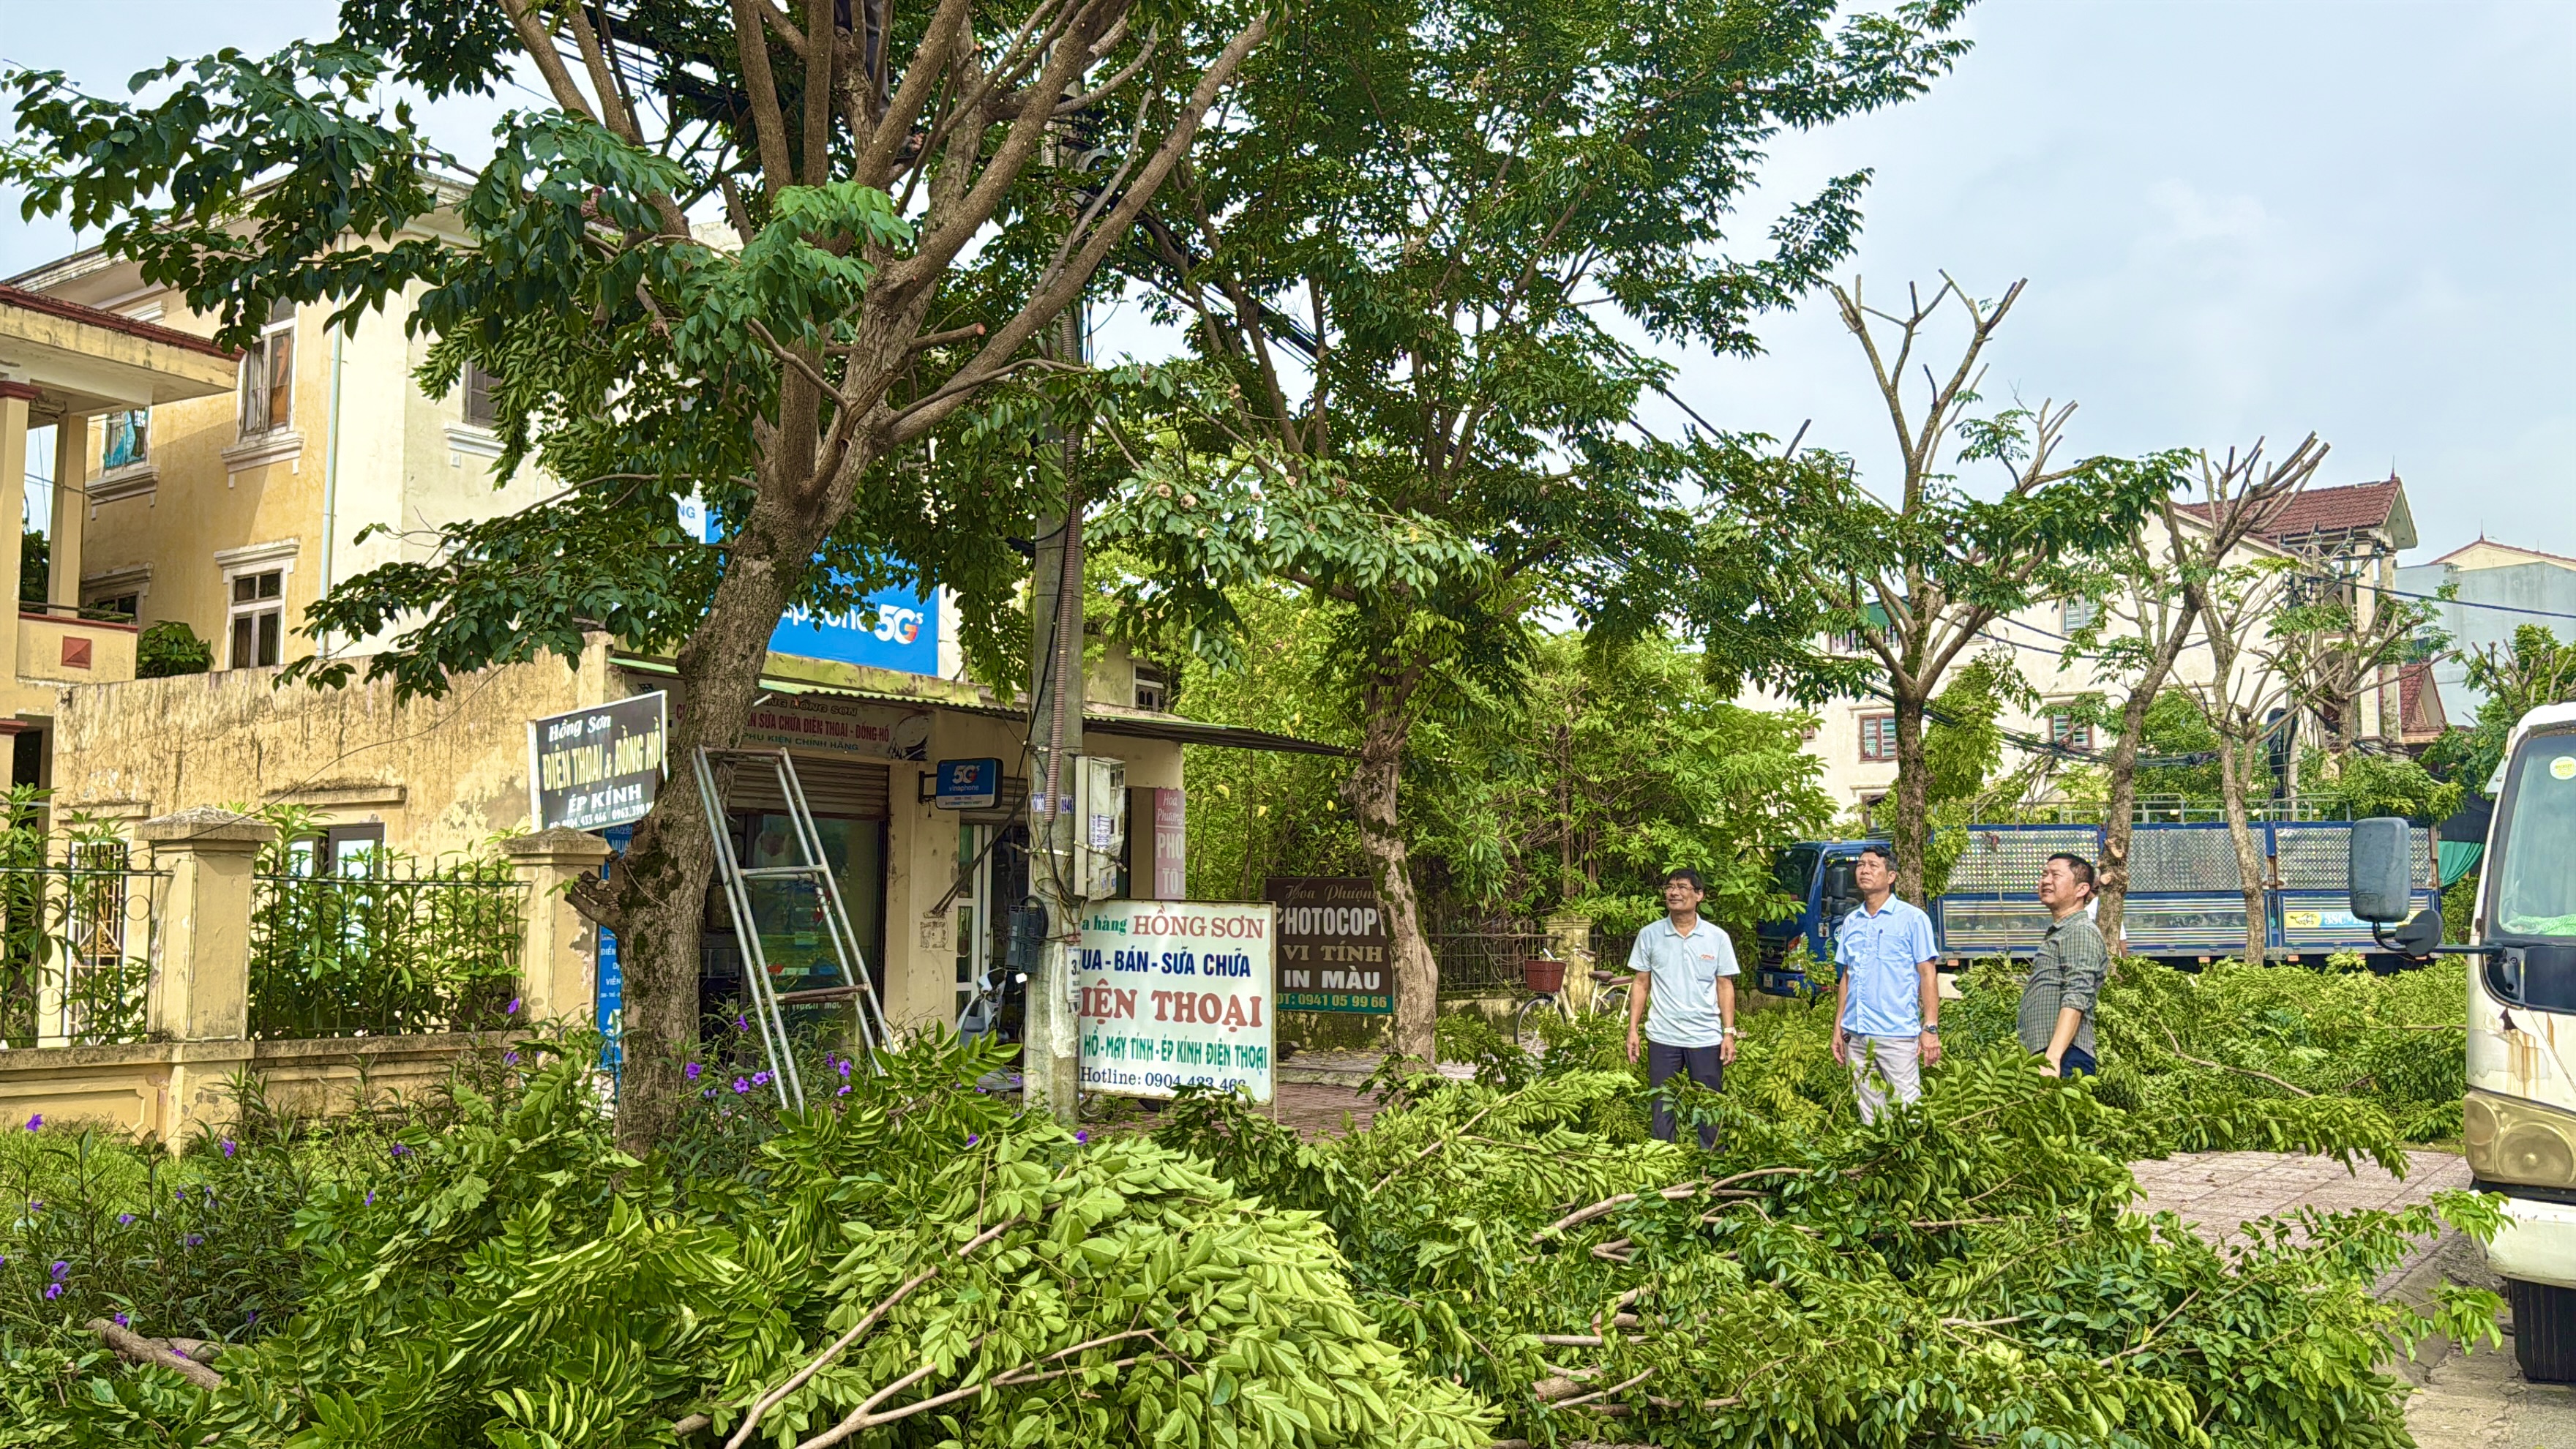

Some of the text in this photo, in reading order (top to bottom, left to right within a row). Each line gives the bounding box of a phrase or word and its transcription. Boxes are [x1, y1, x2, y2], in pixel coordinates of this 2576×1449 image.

[549, 715, 611, 742] Hồng Sơn
[542, 744, 571, 795] ĐIỆN
[604, 752, 612, 778] &
[614, 724, 644, 777] ĐỒNG
[645, 716, 662, 770] HỒ
[567, 783, 643, 815] ÉP KÍNH
[1163, 793, 1177, 806] Hoa
[594, 811, 607, 824] 466
[1157, 833, 1183, 860] PHO
[1093, 914, 1127, 936] hàng
[1132, 905, 1207, 937] HỒNG
[1211, 915, 1265, 939] SƠN
[1114, 946, 1148, 973] BÁN
[1161, 946, 1195, 975] SỮA
[1203, 948, 1251, 977] CHỮA
[1282, 940, 1383, 962] VI TÍNH
[1284, 965, 1380, 990] IN MÀU
[1151, 990, 1262, 1033] THOẠI
[1298, 994, 1328, 1006] 0941
[1332, 995, 1348, 1007] 05
[1352, 995, 1368, 1008] 99
[1371, 996, 1388, 1008] 66
[1084, 1025, 1099, 1058] HỒ
[1106, 1030, 1127, 1060] MÁY
[1130, 1032, 1153, 1063] TÍNH
[1161, 1033, 1174, 1062] ÉP
[1177, 1036, 1202, 1066] KÍNH
[1205, 1038, 1231, 1072] ĐIỆN
[1235, 1044, 1268, 1076] THOẠI
[1080, 1067, 1141, 1085] Hotline:
[1145, 1072, 1182, 1088] 0904
